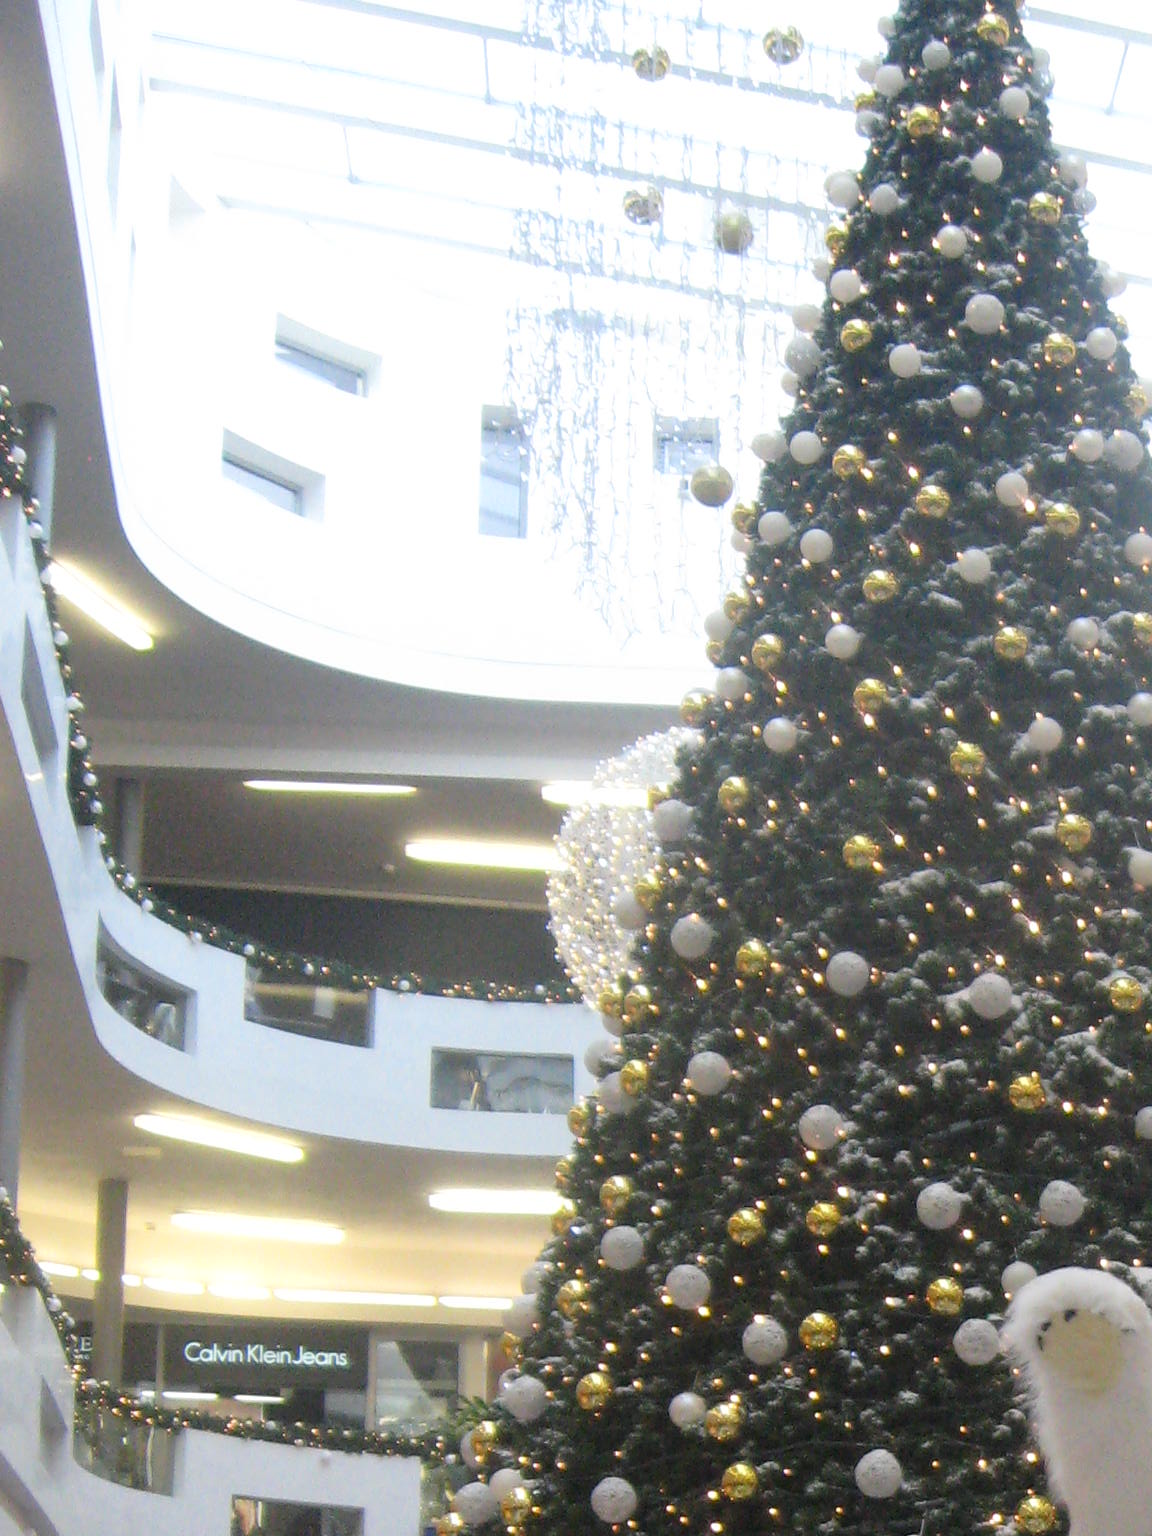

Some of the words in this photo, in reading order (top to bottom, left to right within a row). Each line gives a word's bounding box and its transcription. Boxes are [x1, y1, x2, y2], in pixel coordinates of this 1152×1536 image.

[183, 1341, 244, 1363] Calvin
[246, 1343, 292, 1365] Klein
[291, 1345, 349, 1366] Jeans
